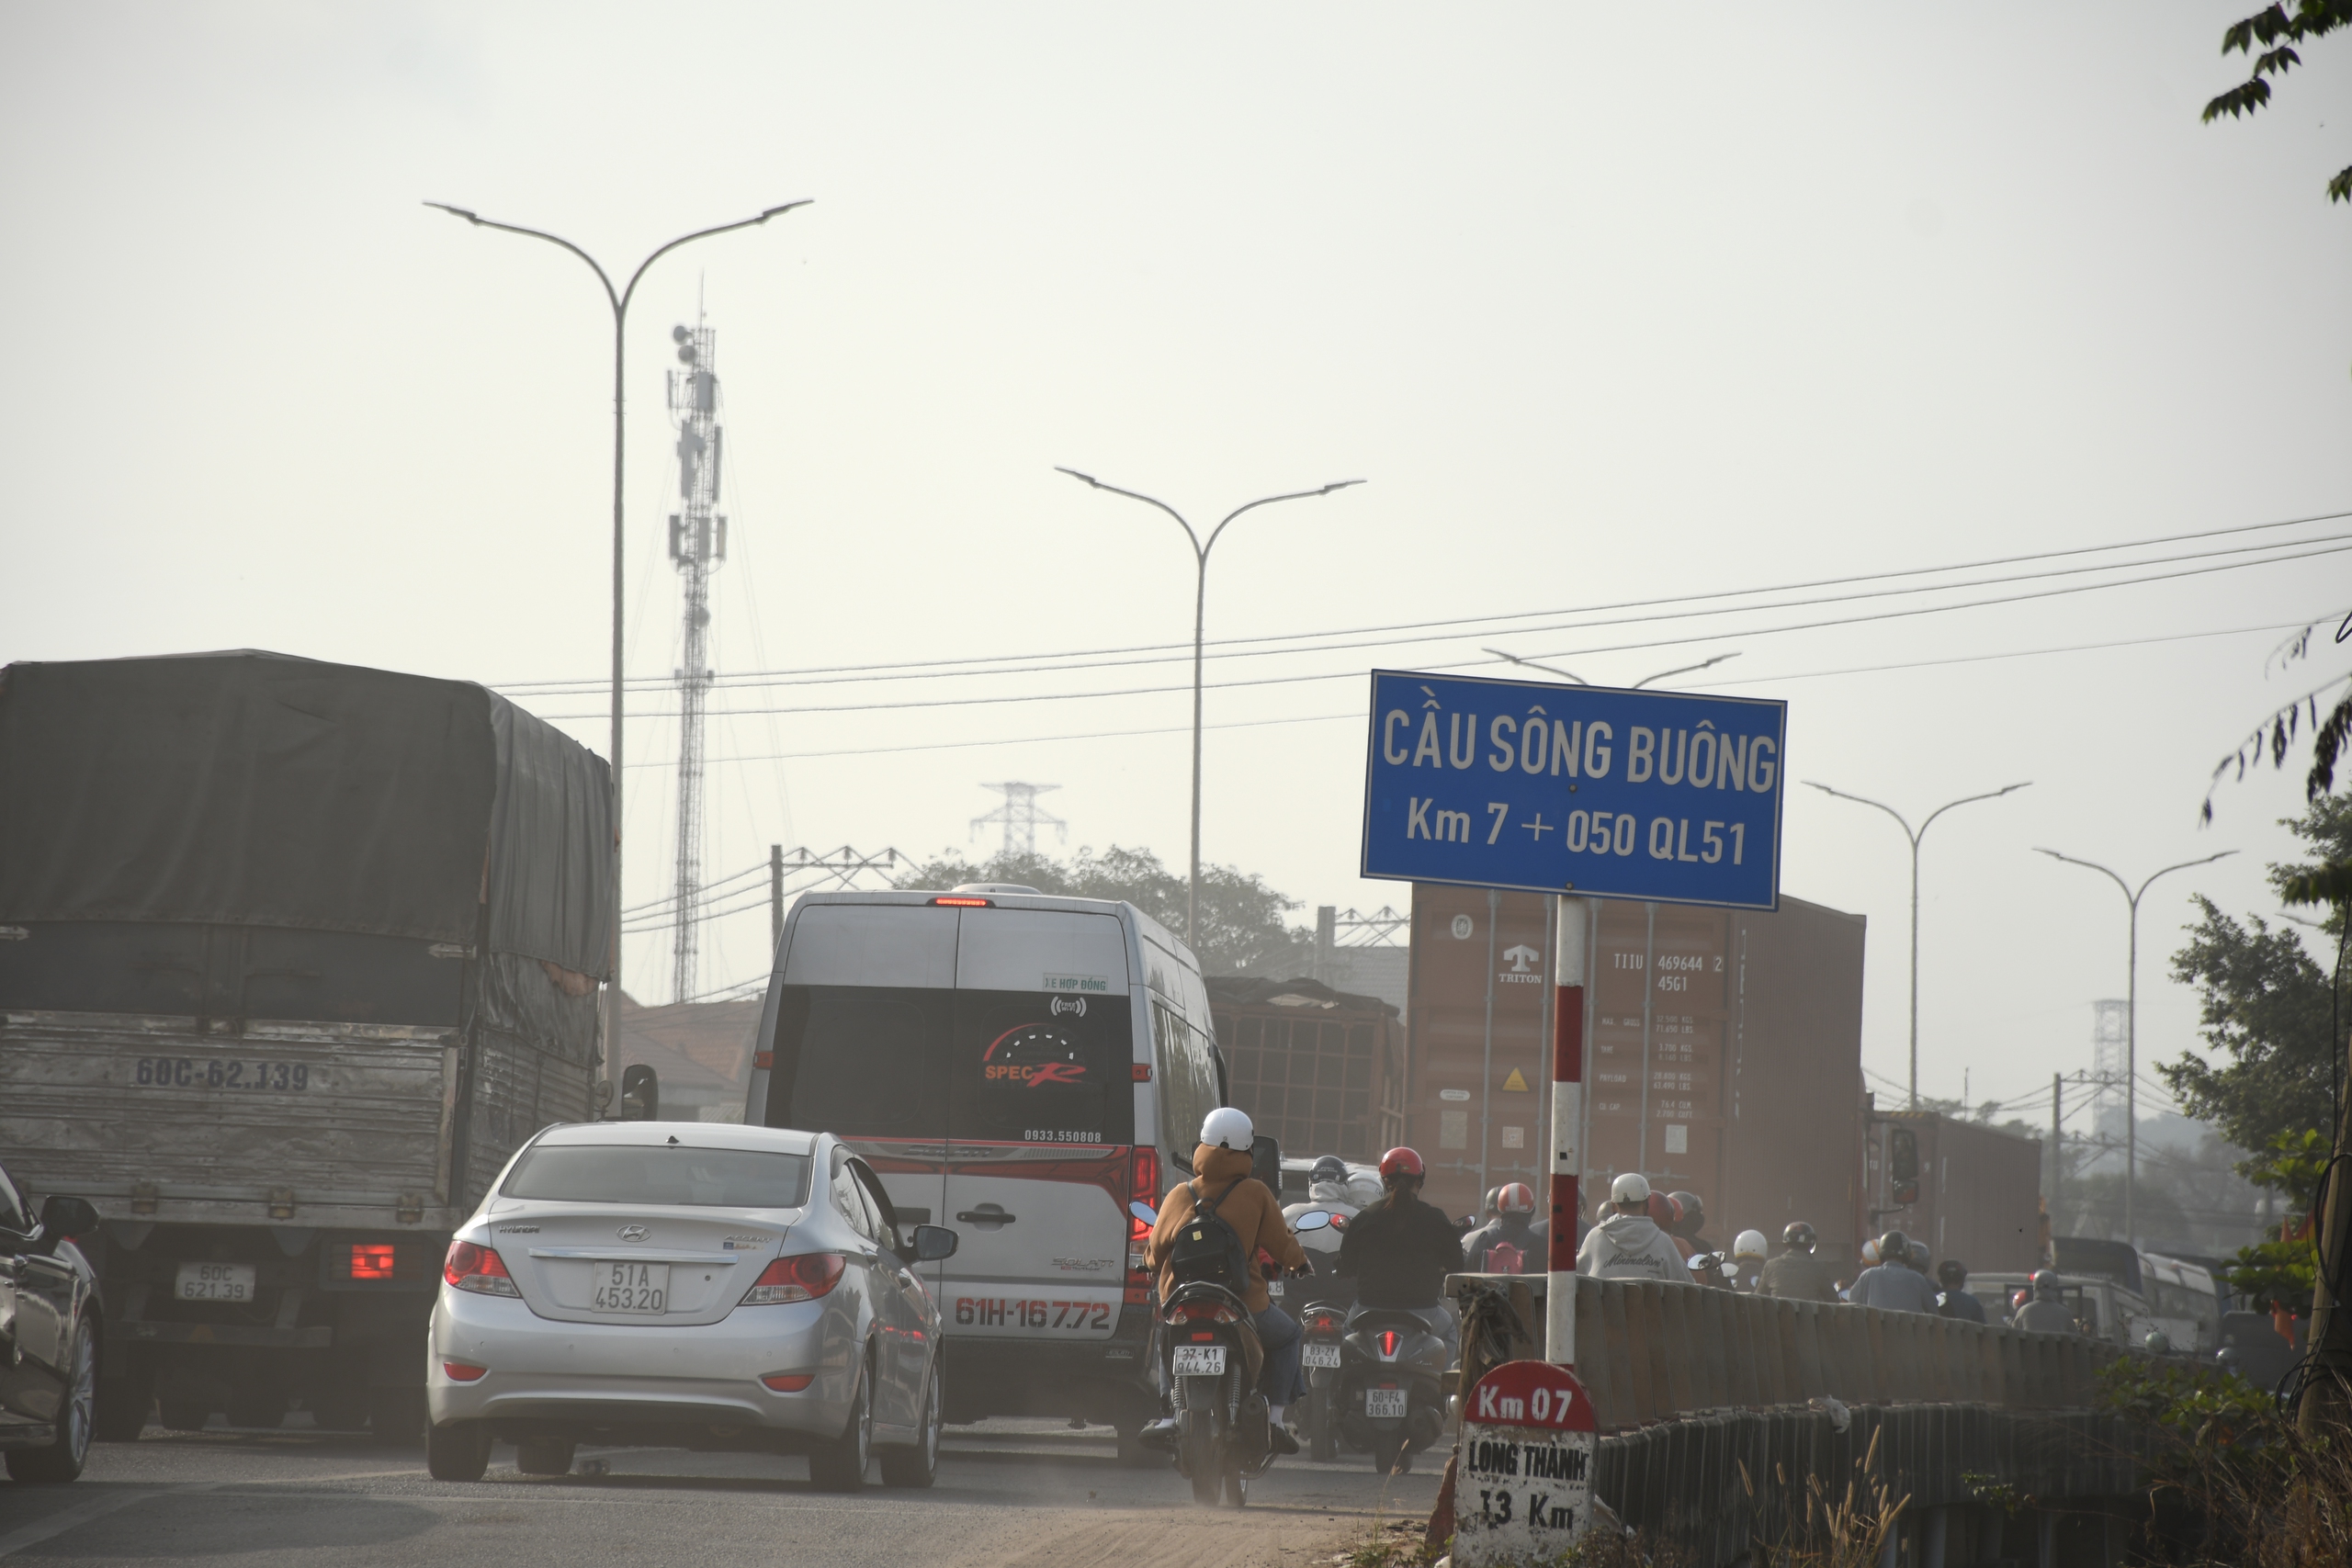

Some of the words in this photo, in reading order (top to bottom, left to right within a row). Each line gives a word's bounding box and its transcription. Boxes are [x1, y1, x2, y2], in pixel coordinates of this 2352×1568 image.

[1383, 685, 1477, 771] CẦU
[1488, 705, 1613, 780] SÔNG
[1626, 719, 1776, 794] BUÔNG
[1407, 796, 1470, 843] Km
[1487, 802, 1510, 845] 7
[1566, 809, 1637, 857] 050
[1648, 817, 1746, 865] QL51
[1614, 953, 1644, 970] TIIU
[1657, 954, 1702, 972] 469644
[1714, 956, 1723, 972] 2
[1059, 977, 1079, 991] HỢP
[1498, 973, 1543, 984] TRITON
[1657, 976, 1688, 991] 45G1
[1599, 1074, 1627, 1083] PAYLOAD
[1023, 1129, 1102, 1144] 0933.550808
[499, 1224, 540, 1235] HYUNDAI
[724, 1235, 774, 1244] ACCENT
[1051, 1256, 1115, 1268] SOLATI
[199, 1265, 233, 1281] 60C
[611, 1264, 650, 1287] 51A
[184, 1281, 245, 1299] 621.39
[595, 1287, 663, 1311] 453.20
[1177, 1361, 1221, 1374] 944.26
[1305, 1356, 1339, 1367] 046.24
[1372, 1391, 1400, 1404] 60-F4
[1478, 1385, 1524, 1420] Km
[1532, 1387, 1573, 1424] 07
[1368, 1404, 1404, 1416] 366.10
[1468, 1440, 1519, 1476] LONG
[1529, 1494, 1574, 1530] Km
